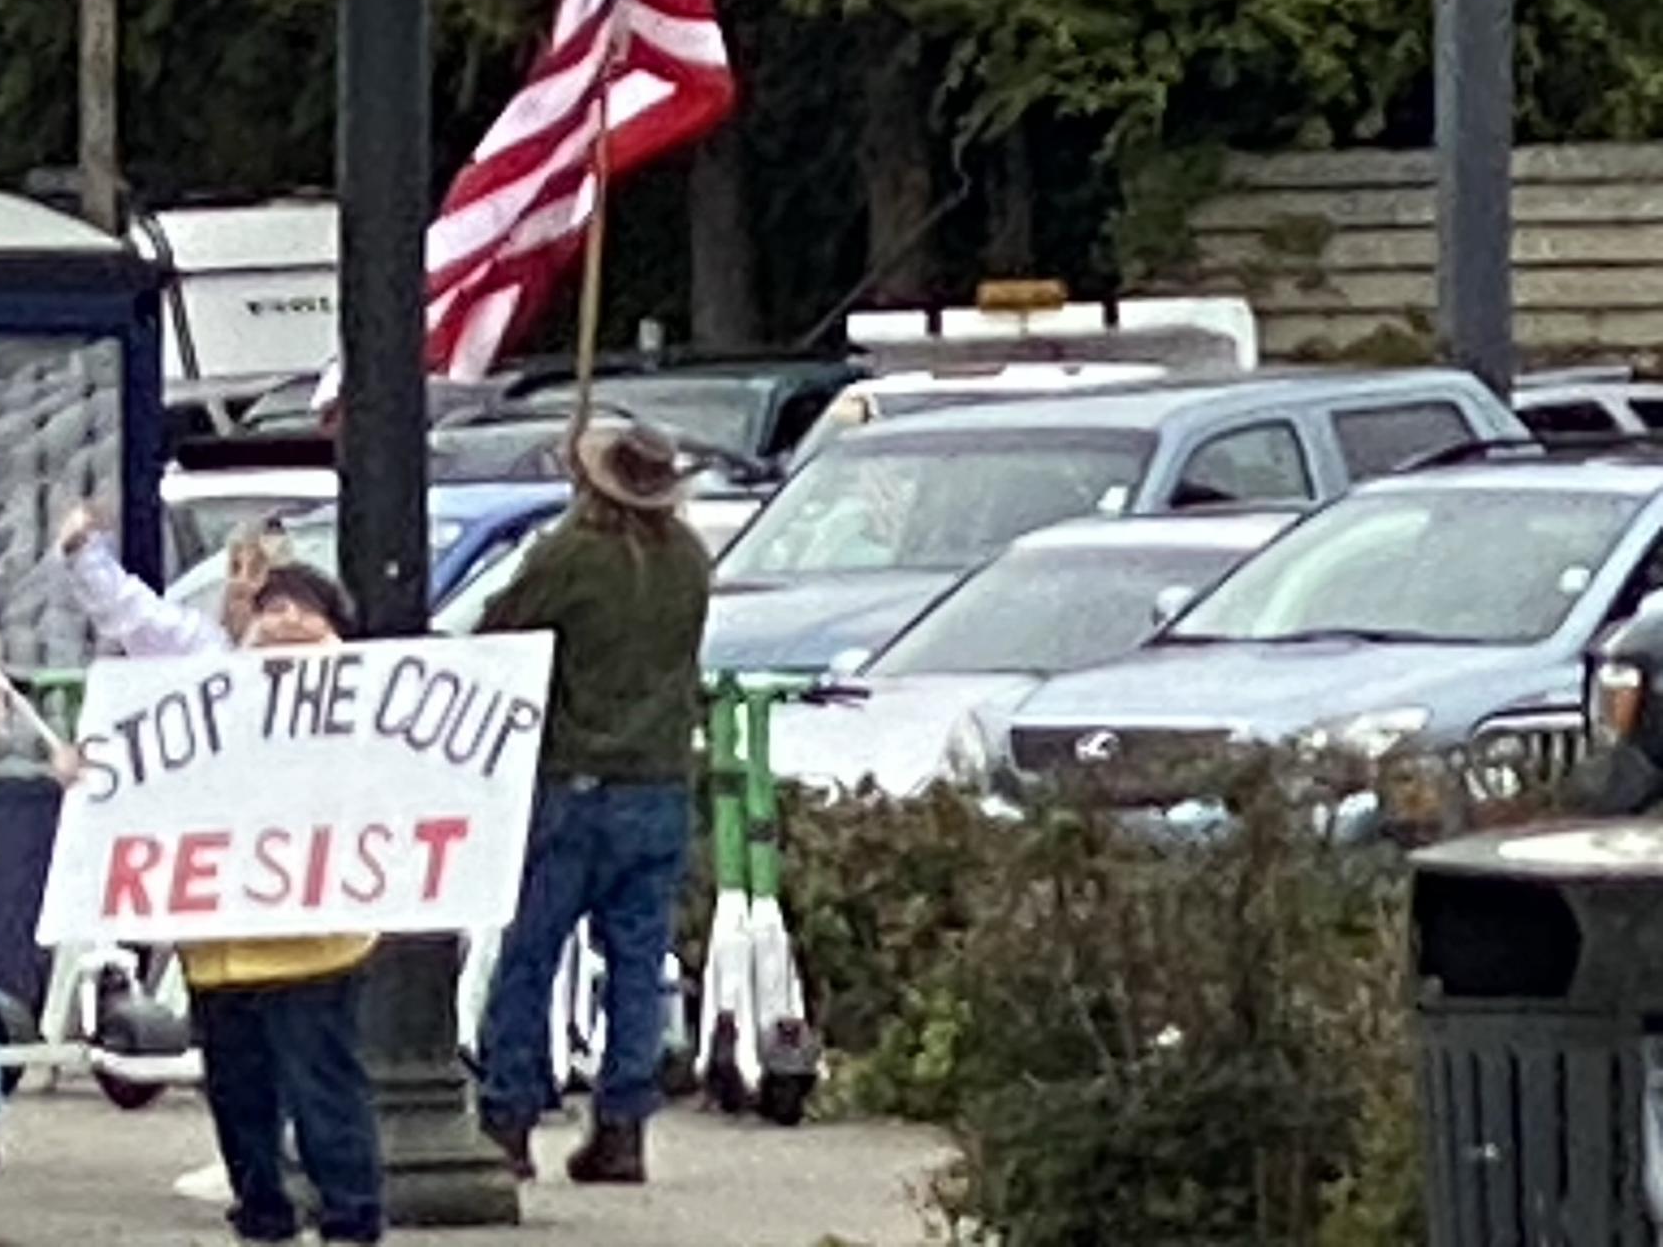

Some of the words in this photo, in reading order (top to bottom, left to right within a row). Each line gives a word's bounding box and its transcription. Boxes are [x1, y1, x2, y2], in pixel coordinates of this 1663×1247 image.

[78, 673, 232, 803] STOP
[262, 654, 365, 740] THE
[375, 655, 541, 778] COUP
[101, 816, 470, 919] RESIST
